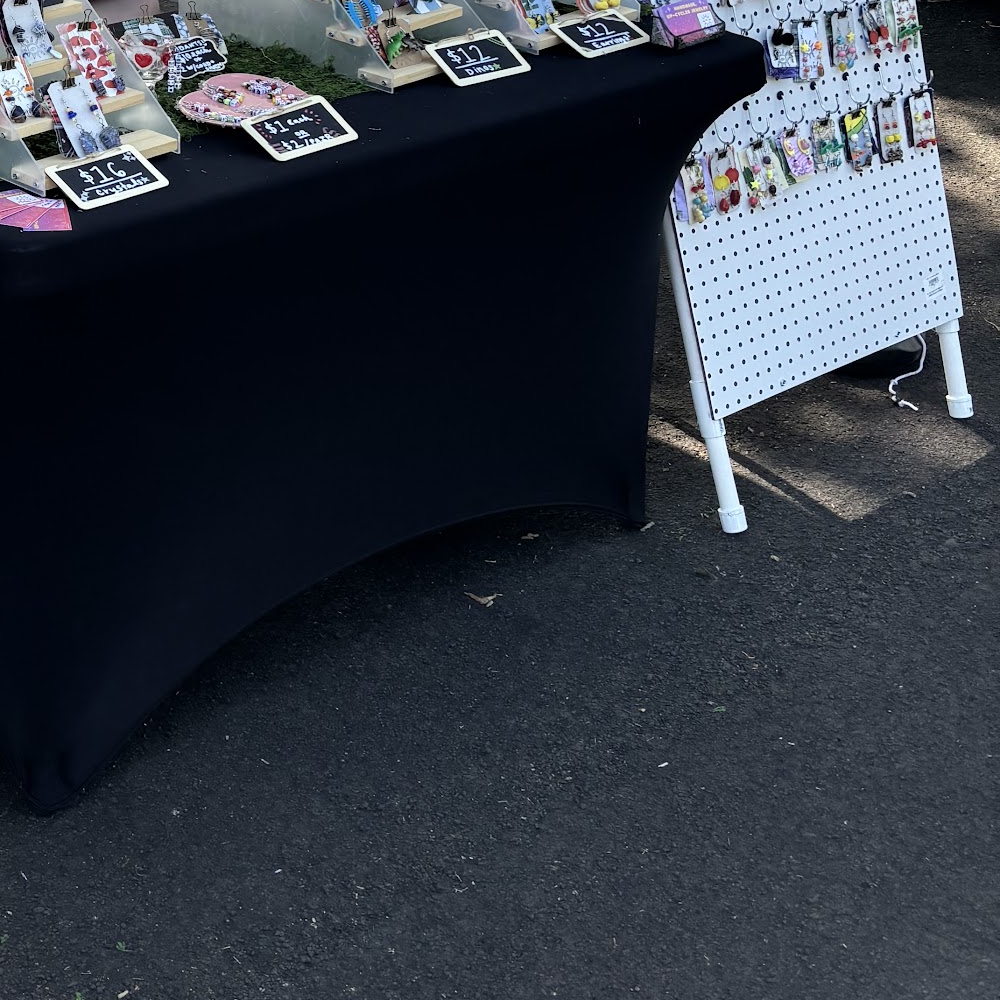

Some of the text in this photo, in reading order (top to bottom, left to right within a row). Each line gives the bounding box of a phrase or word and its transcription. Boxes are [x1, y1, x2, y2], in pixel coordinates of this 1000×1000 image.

[580, 21, 616, 38] $12
[446, 46, 491, 64] $12
[465, 65, 494, 77] Dinos
[263, 120, 290, 135] $1
[79, 161, 127, 185] $16
